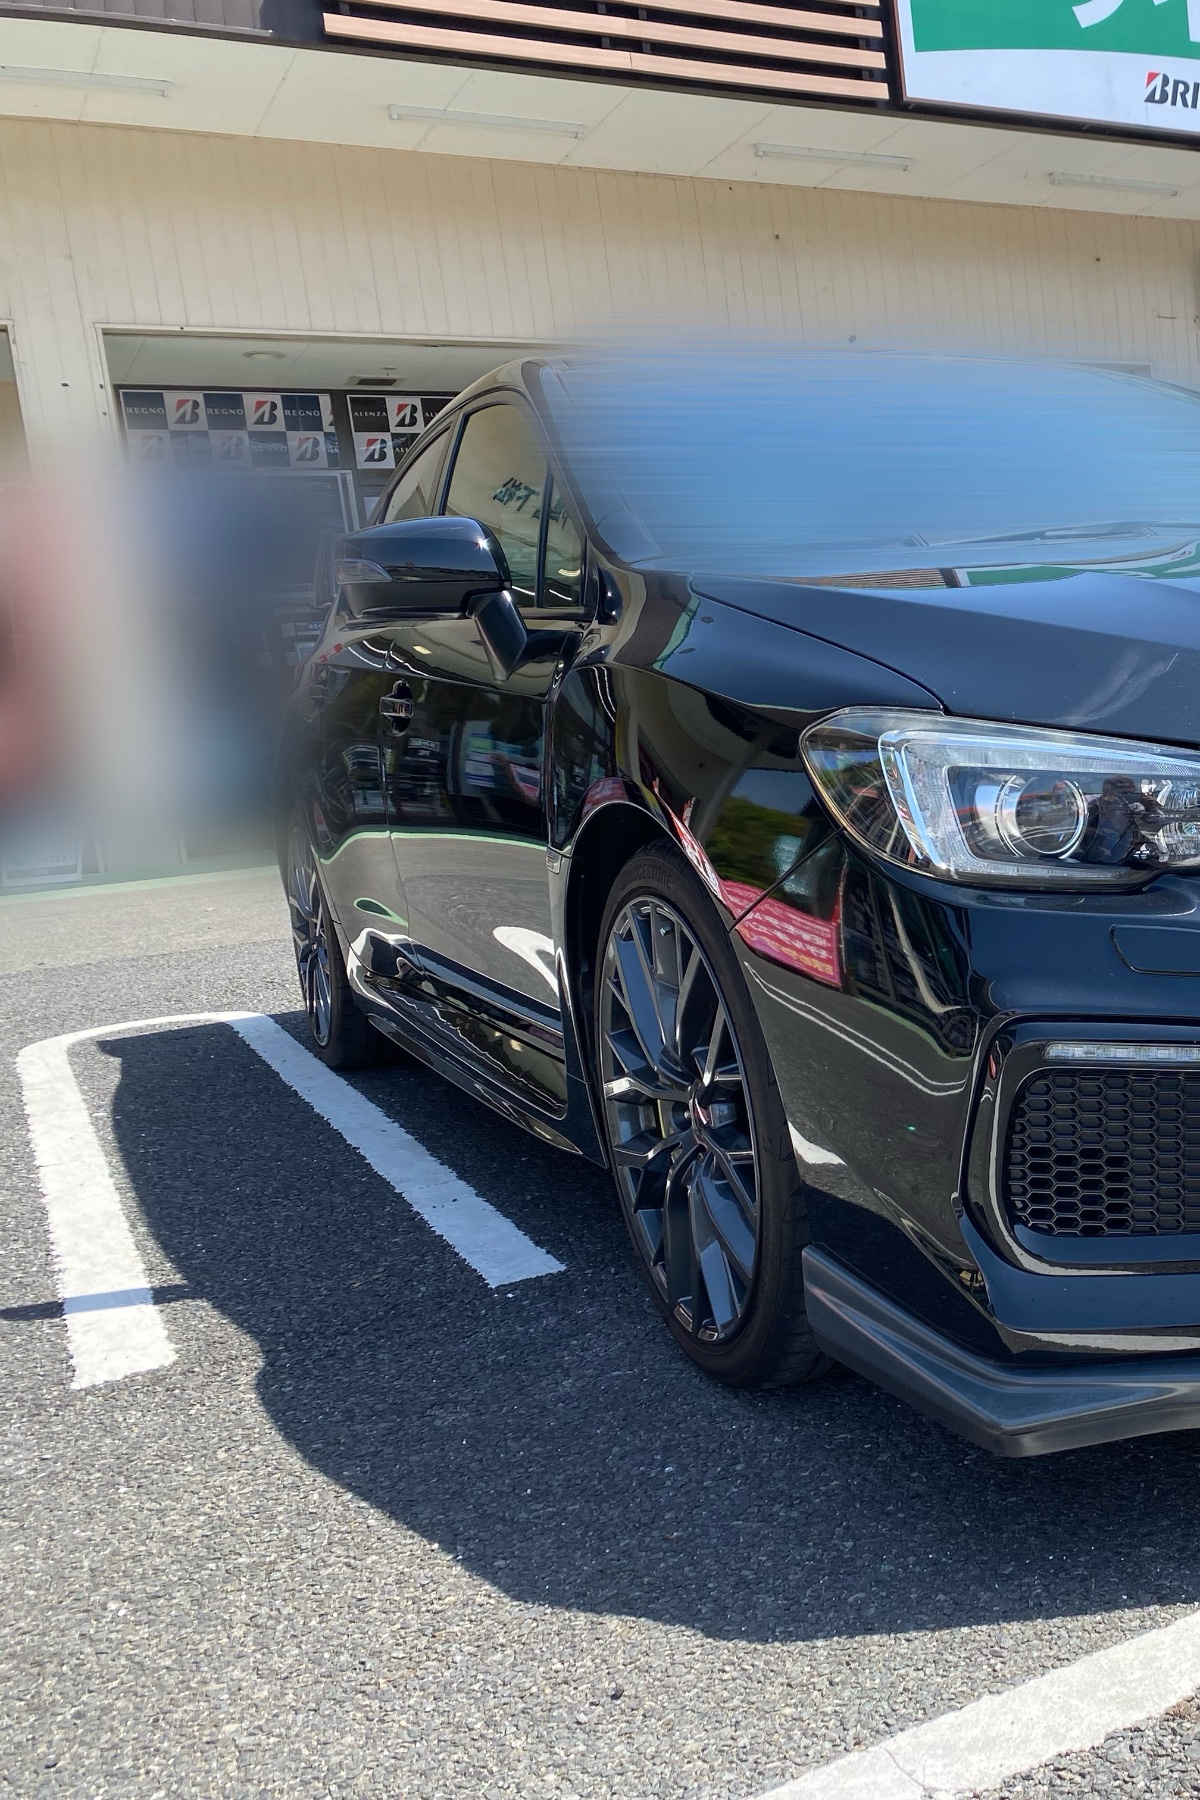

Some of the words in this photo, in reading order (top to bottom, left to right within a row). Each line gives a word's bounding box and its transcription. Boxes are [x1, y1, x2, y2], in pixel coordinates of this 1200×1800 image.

[126, 406, 165, 415] REGNO
[206, 407, 243, 416] REGNO
[285, 409, 320, 417] REGNO
